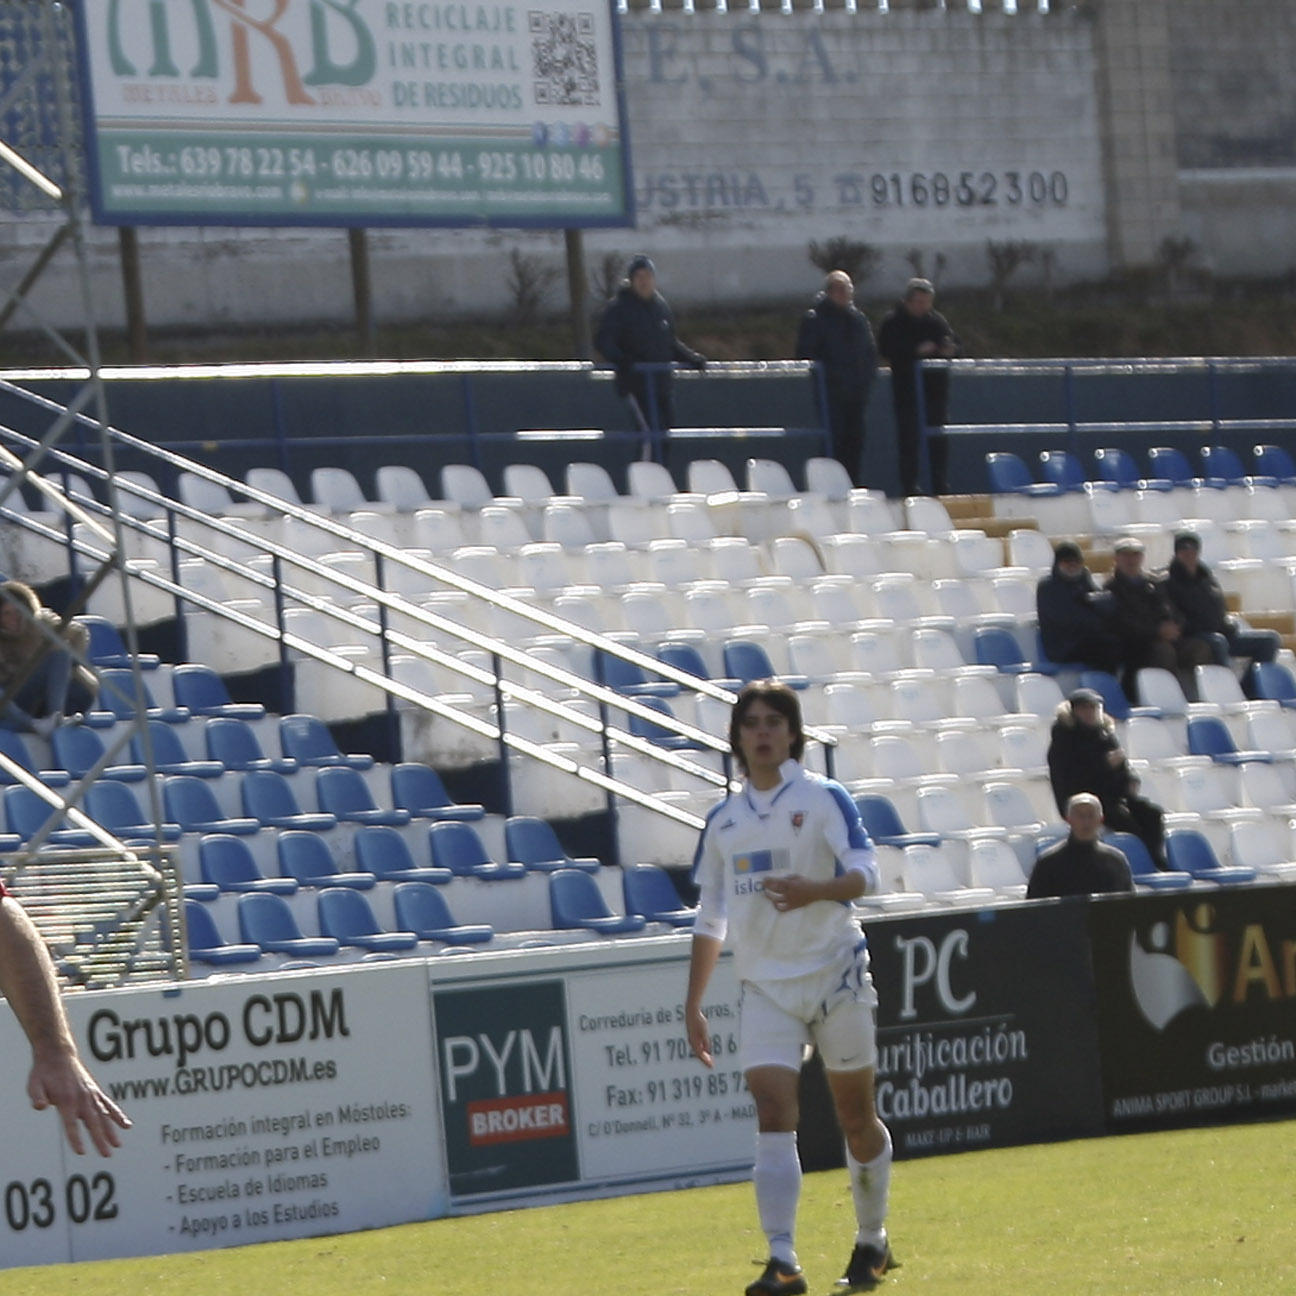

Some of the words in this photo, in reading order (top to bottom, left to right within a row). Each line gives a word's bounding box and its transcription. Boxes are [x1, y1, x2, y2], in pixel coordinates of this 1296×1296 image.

[385, 1, 516, 32] RECICLAJE
[388, 41, 519, 71] INTEGRAL
[392, 80, 419, 108] DE
[424, 81, 523, 110] RESIDUOS
[181, 147, 221, 175] 639
[226, 147, 253, 176] 78
[257, 147, 285, 176] 22
[290, 148, 317, 177] 54
[332, 149, 372, 177] 626
[376, 149, 402, 178] 09
[407, 151, 433, 178] 59
[437, 151, 464, 179] 44
[479, 152, 516, 179] 925
[522, 153, 545, 180] 10
[579, 154, 605, 180] 46
[635, 172, 787, 212] USTRIA,
[894, 928, 977, 1019] PC
[88, 1006, 231, 1068] Grupo
[242, 986, 351, 1047] CDM
[656, 1008, 673, 1024] de
[675, 1003, 735, 1022] Suros,
[443, 1024, 567, 1102] PYM
[605, 1044, 638, 1068] Tel.
[642, 1041, 661, 1063] 91
[666, 1037, 695, 1061] 70
[876, 1022, 1029, 1079] urificación
[1207, 1034, 1295, 1070] Gestión
[109, 1057, 338, 1101] www.GRUPOCDM.es
[606, 1084, 643, 1108] Fax:
[647, 1079, 667, 1103] 91
[672, 1076, 703, 1101] 319
[707, 1072, 729, 1096] 85
[877, 1073, 1014, 1121] Caballero
[161, 1117, 248, 1145] Formación
[251, 1112, 312, 1137] integral
[316, 1109, 334, 1128] en
[471, 1102, 565, 1137] BROKER
[731, 1104, 756, 1120] MAD
[175, 1147, 262, 1174] Formación
[264, 1146, 300, 1168] para
[304, 1142, 318, 1161] el
[322, 1134, 381, 1160] Empleo
[5, 1177, 56, 1233] 03
[65, 1170, 120, 1225] 02
[178, 1179, 241, 1206] Escuela
[245, 1176, 264, 1197] de
[268, 1171, 329, 1195] Idiomas
[180, 1213, 229, 1239] Apoyo
[232, 1214, 242, 1229] a
[246, 1208, 270, 1227] los
[274, 1199, 341, 1225] Estudios
